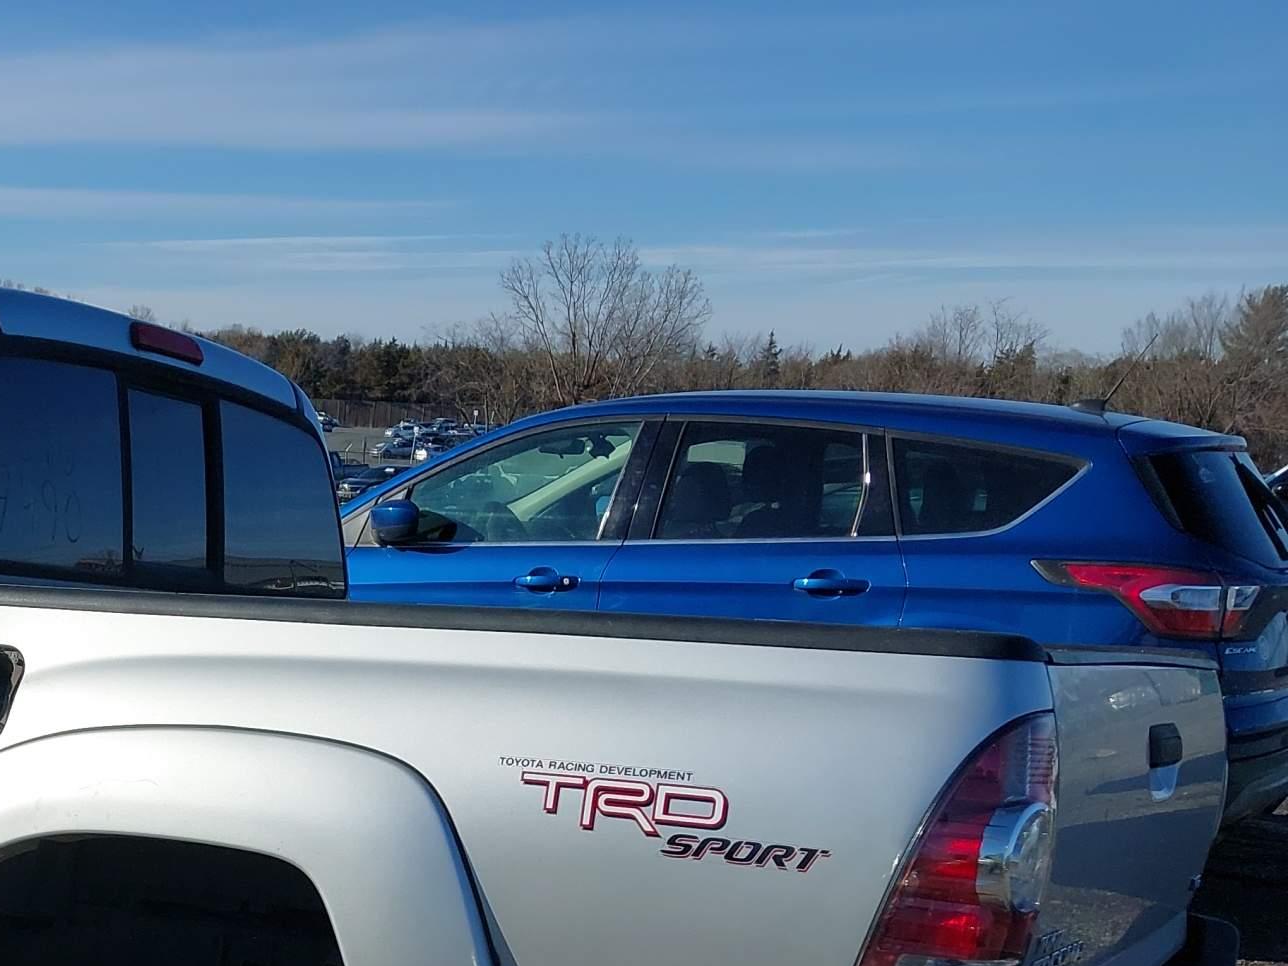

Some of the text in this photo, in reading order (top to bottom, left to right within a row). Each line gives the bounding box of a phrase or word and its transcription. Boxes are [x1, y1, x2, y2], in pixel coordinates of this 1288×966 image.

[499, 756, 694, 782] TOYOTA RACING DEVELOPMENT
[520, 770, 729, 838] TRD
[660, 834, 833, 873] SPORT
